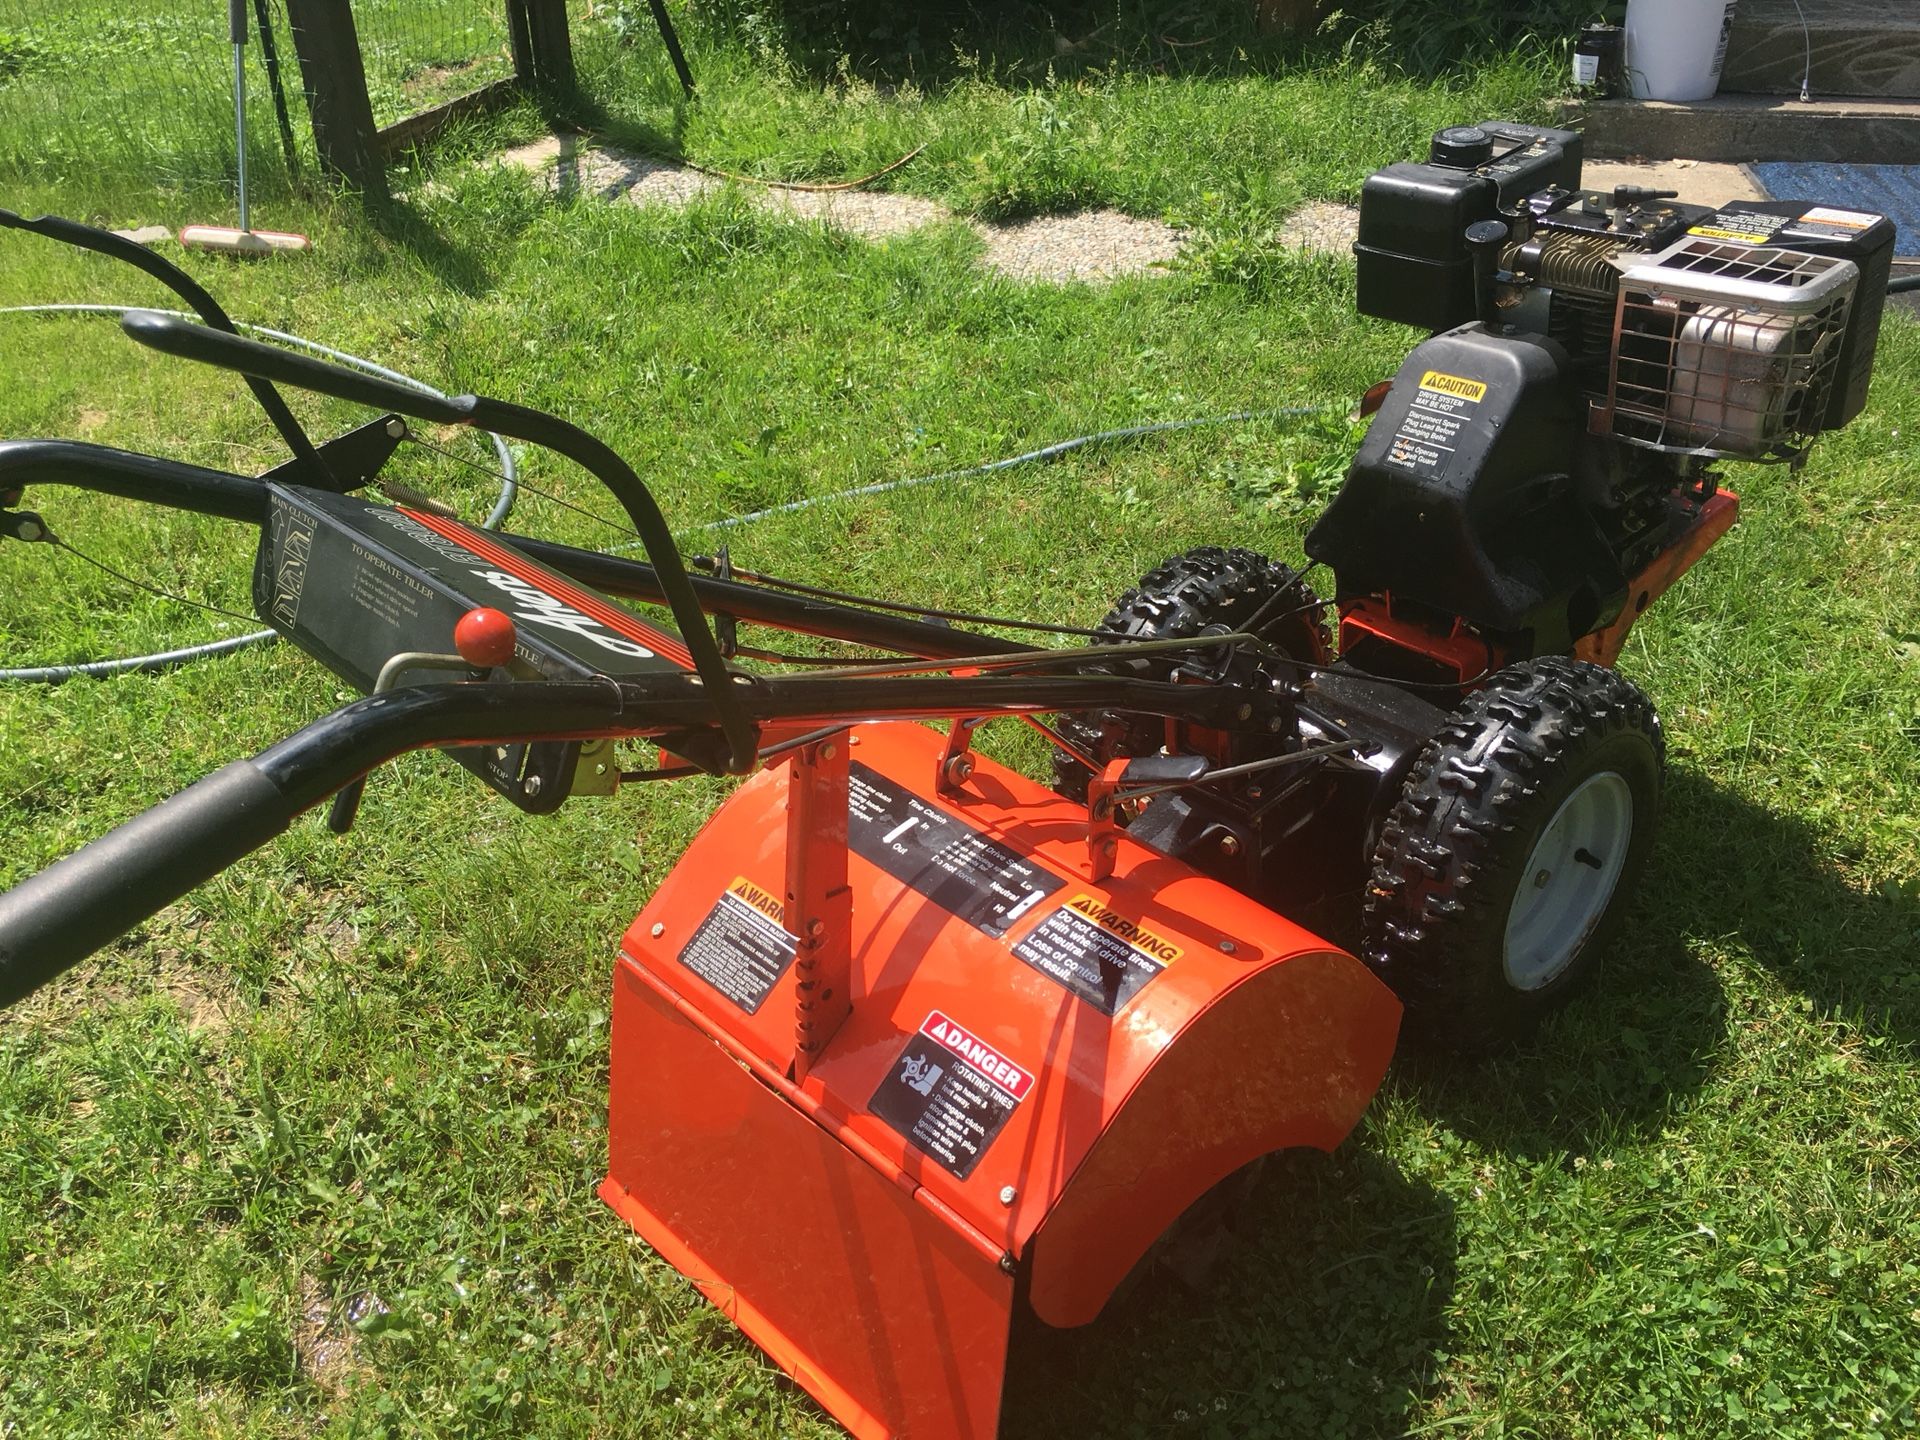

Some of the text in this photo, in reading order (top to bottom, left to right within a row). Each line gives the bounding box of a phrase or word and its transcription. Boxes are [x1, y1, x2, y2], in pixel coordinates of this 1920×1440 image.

[1699, 230, 1740, 239] CAUTION
[1419, 390, 1464, 407] DRIVE SYSTEM
[1437, 377, 1482, 398] CAUTION
[1415, 396, 1454, 412] MAY BE HOT
[1405, 418, 1456, 436] Plug Lead Before
[1409, 411, 1460, 429] Disconnect Spark
[1402, 425, 1447, 442] Changing Belts
[1387, 455, 1415, 468] Removed
[1415, 447, 1438, 458] Operate
[1418, 456, 1438, 466] Guard
[271, 494, 318, 529] MAIN CLUTCH
[352, 543, 434, 600] TO OPERATE TILLER
[470, 569, 655, 658] Ariens
[514, 642, 539, 664] TTLE
[488, 761, 508, 779] STOP
[866, 800, 885, 813] loaded
[875, 791, 892, 802] clutch
[909, 799, 947, 824] Tine Clutch
[921, 822, 929, 830] In
[893, 843, 908, 854] Out
[953, 840, 969, 853] When
[993, 866, 1013, 878] speed
[963, 833, 1032, 876] Wheel Drive Speed
[931, 855, 976, 887] Do not force.
[989, 881, 1020, 902] Neutral
[1021, 880, 1032, 891] Lo
[747, 886, 785, 923] WARN
[993, 903, 1006, 914] Hi
[734, 903, 749, 915] AVOID
[749, 913, 769, 928] SERIOUS
[769, 926, 787, 940] INJURY
[1091, 903, 1178, 962] WARNING
[1027, 935, 1053, 953] Loss
[1052, 950, 1065, 960] of
[1038, 925, 1087, 957] in neutral.
[1048, 918, 1127, 967] with wheel drive
[1057, 911, 1156, 971] Do not operate tines
[1016, 944, 1073, 980] may result.
[945, 1025, 1021, 1089] DANGER
[942, 1085, 970, 1109] feet away.
[947, 1077, 962, 1091] Keep
[963, 1088, 981, 1104] hands
[952, 1062, 1013, 1108] ROTATING TINES
[929, 1103, 941, 1115] stop
[942, 1113, 962, 1131] engine
[934, 1095, 985, 1135] Disengage clutch,
[918, 1119, 952, 1147] ignition wire
[924, 1111, 976, 1153] remove spark plug
[913, 1127, 956, 1163] before clearing.
